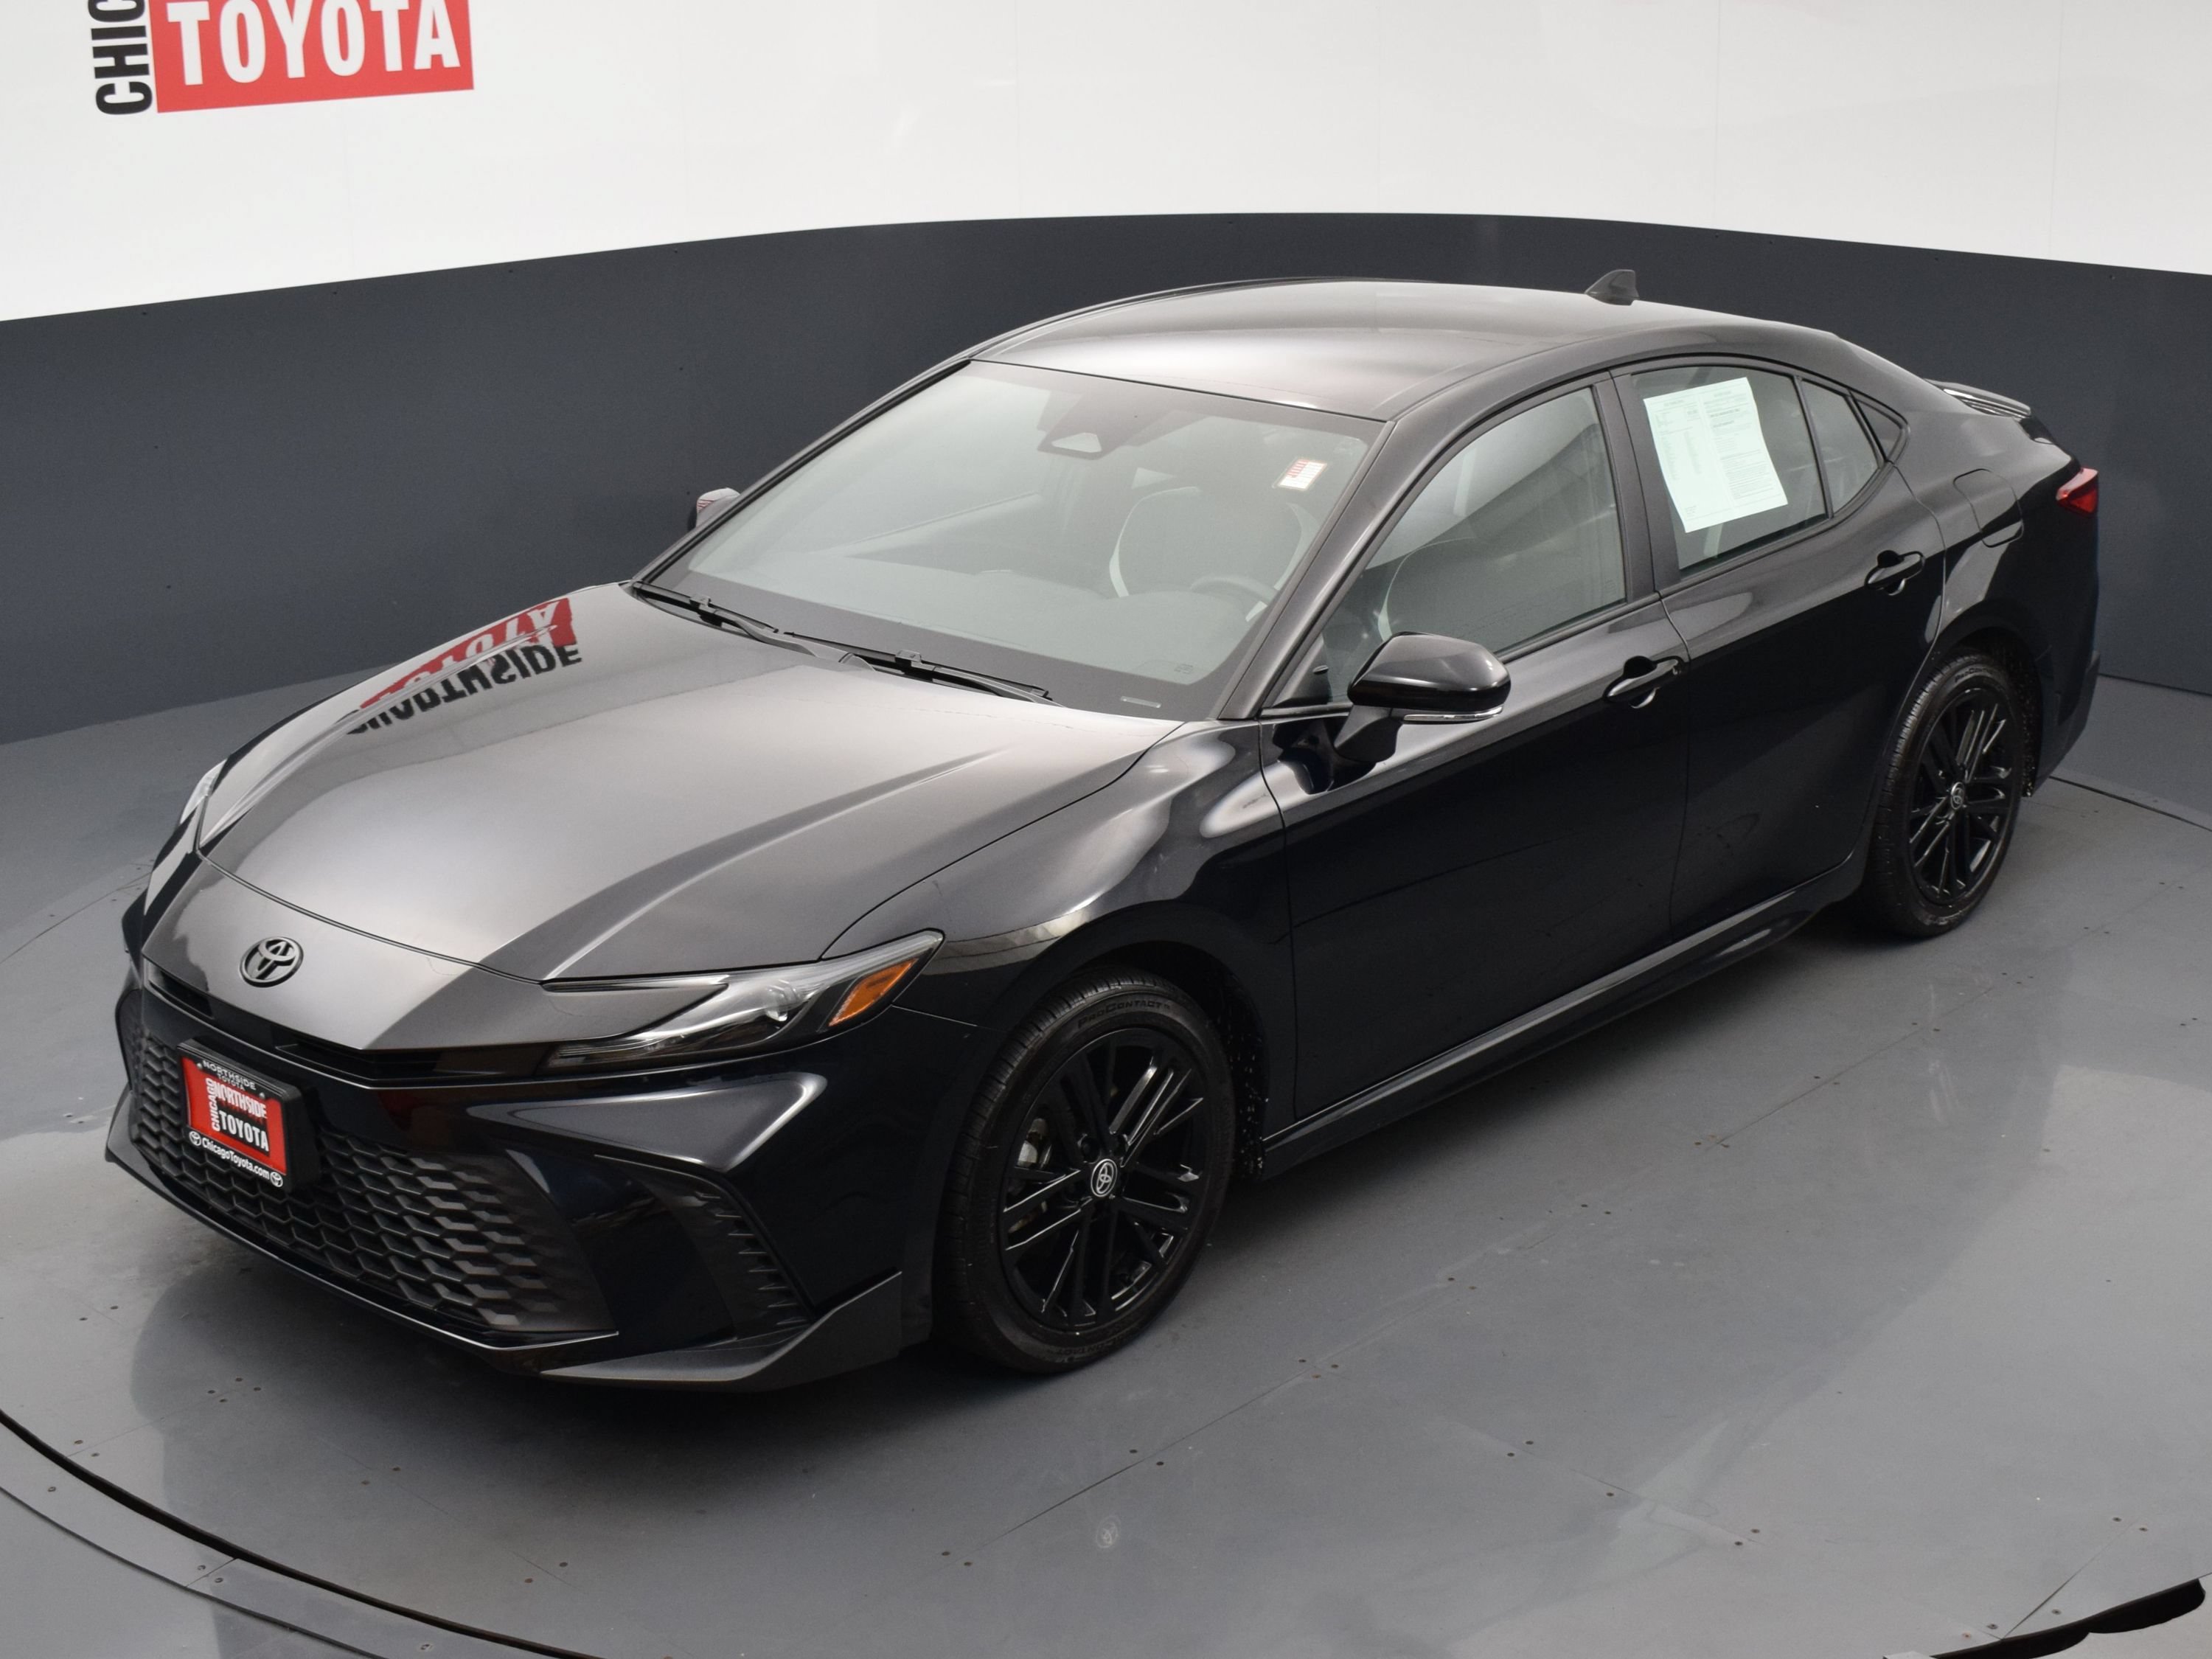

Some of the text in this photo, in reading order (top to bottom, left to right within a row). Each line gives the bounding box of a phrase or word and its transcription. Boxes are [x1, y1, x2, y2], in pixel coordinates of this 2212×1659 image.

[167, 0, 461, 86] TOYOTA
[203, 1060, 257, 1091] NORTHSIDE
[217, 1073, 246, 1091] TOYOTA
[205, 1077, 221, 1132] CHICAGO
[215, 1082, 268, 1119] NORTHSIDE
[218, 1110, 270, 1152] TOYOTA
[202, 1137, 271, 1180] ChicagoToyota.com
